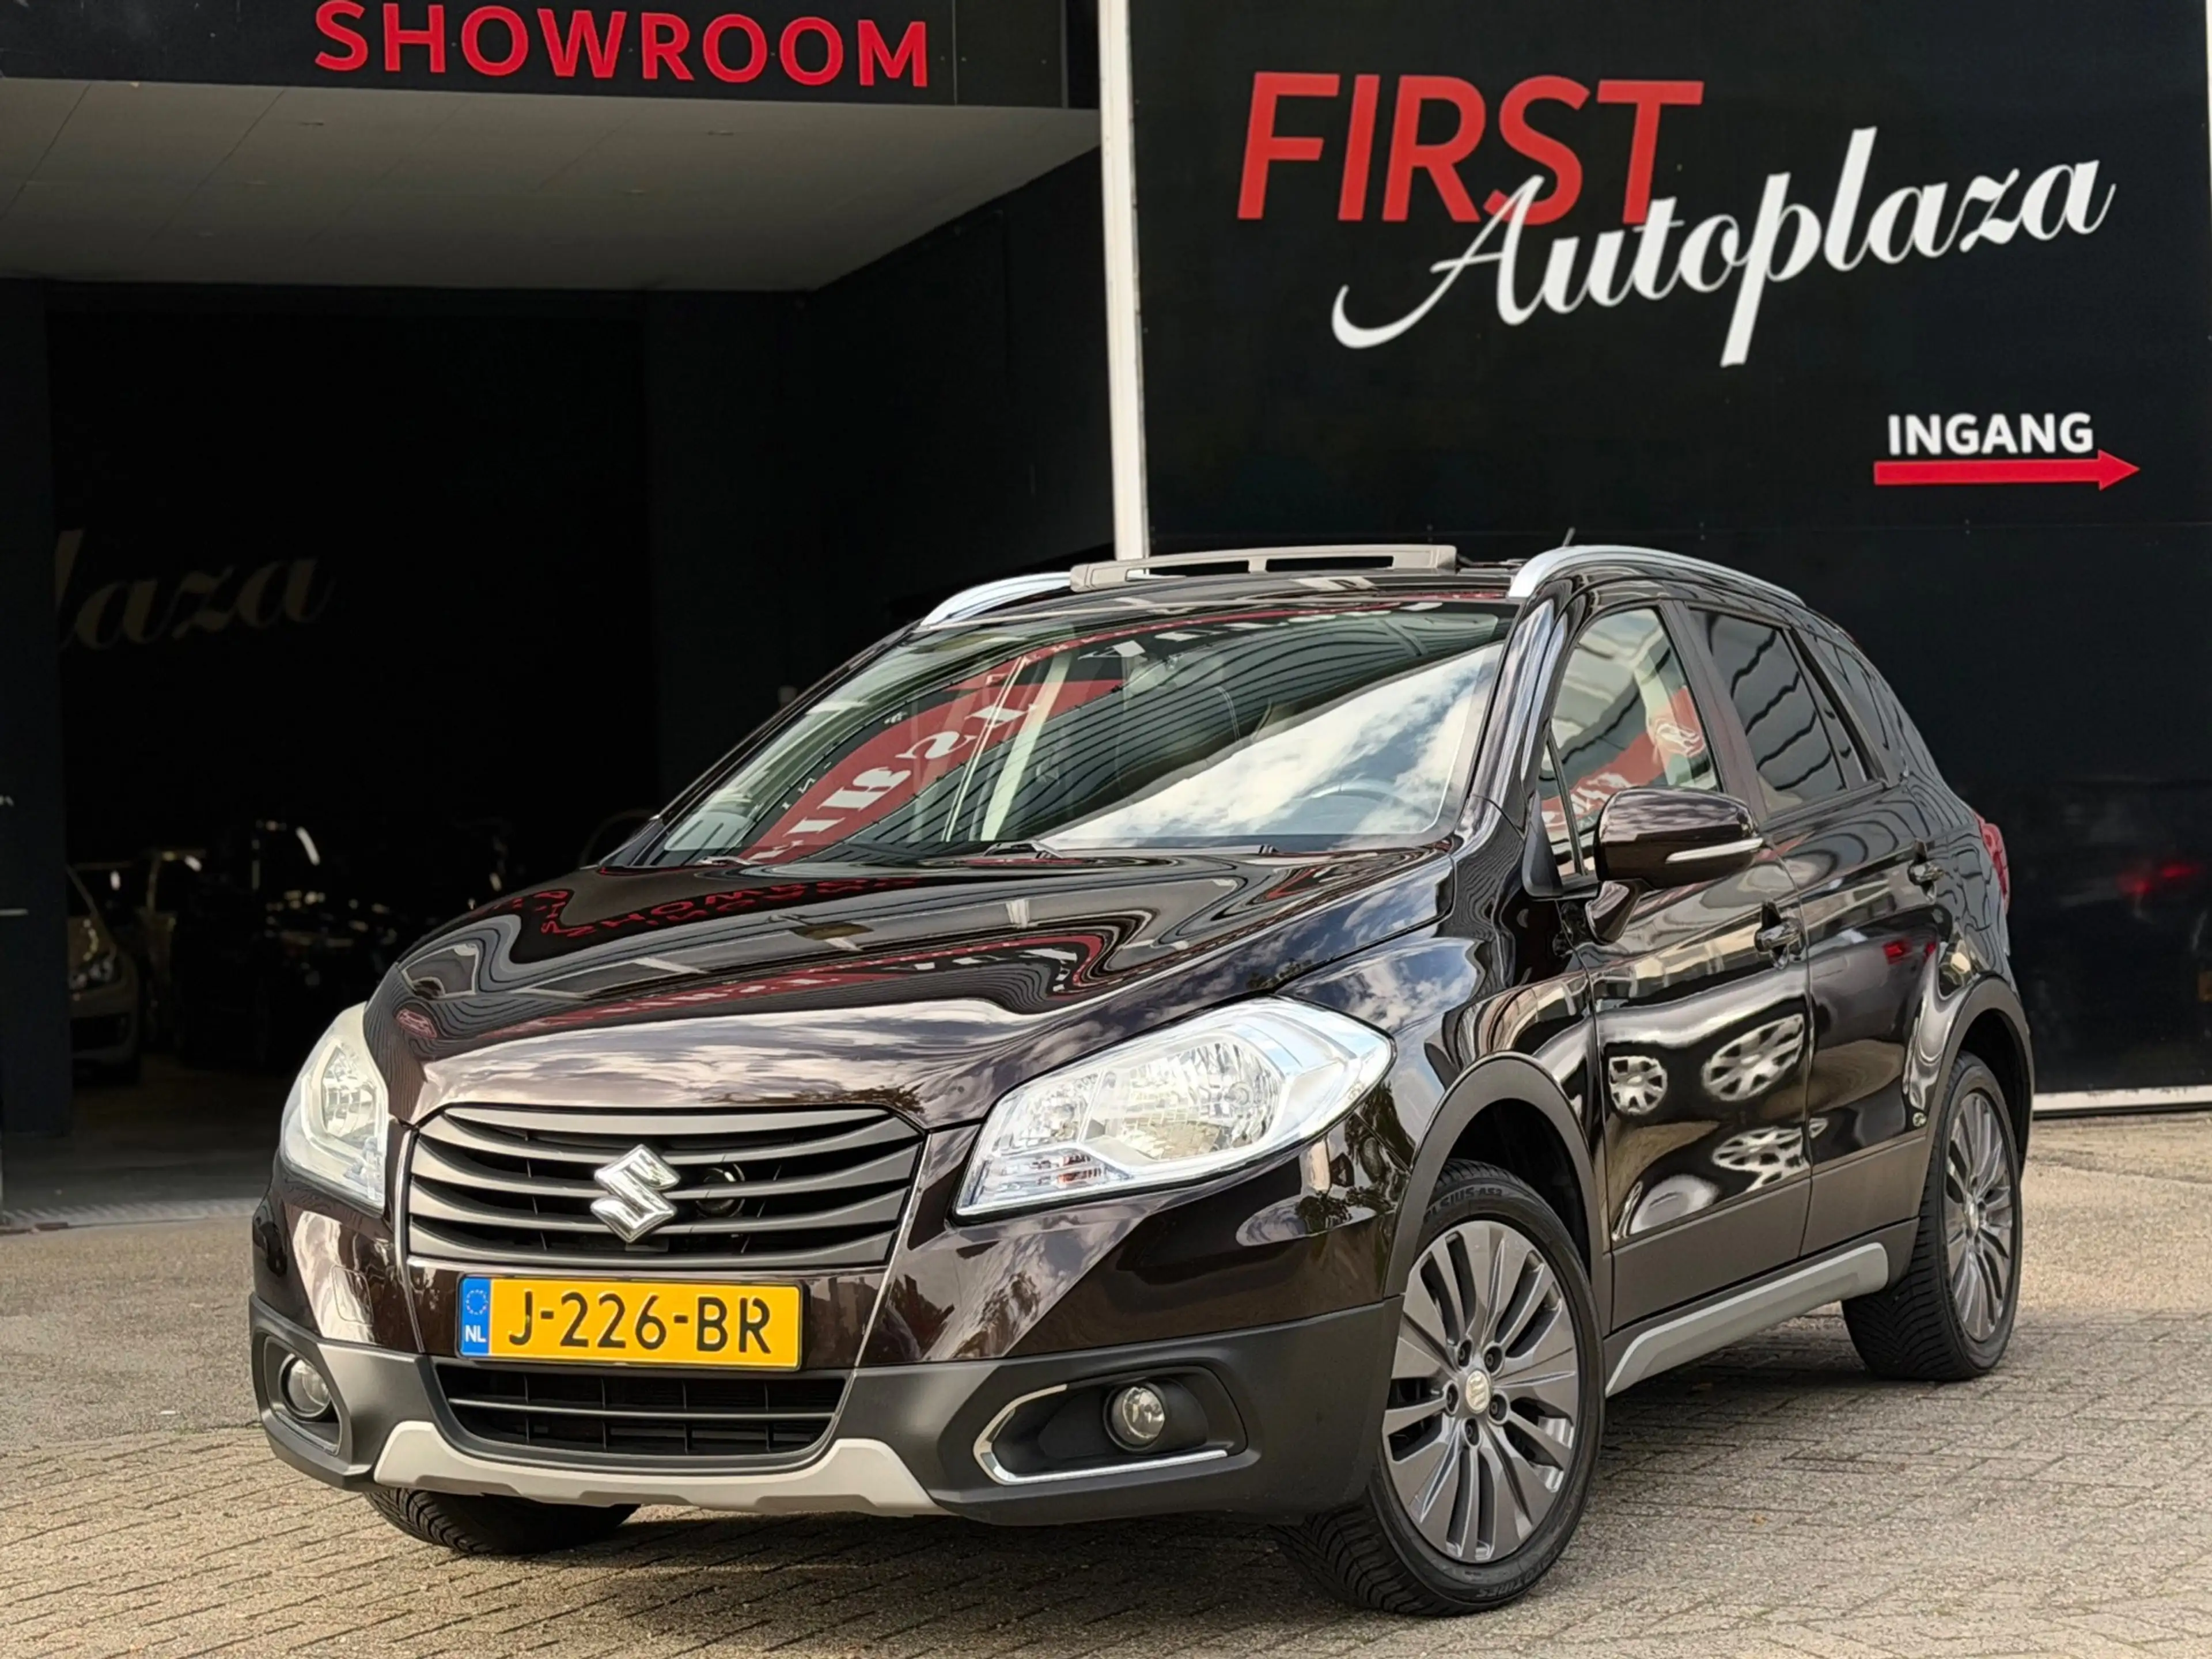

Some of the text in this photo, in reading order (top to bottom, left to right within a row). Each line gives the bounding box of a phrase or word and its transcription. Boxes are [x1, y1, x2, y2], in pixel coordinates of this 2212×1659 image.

[315, 0, 927, 88] SHOWROOM
[1237, 72, 1704, 225] FIRST
[1331, 126, 2116, 367] Autoplaza
[1888, 412, 2094, 456] INGANG
[465, 1290, 771, 1354] NL J-226-BR
